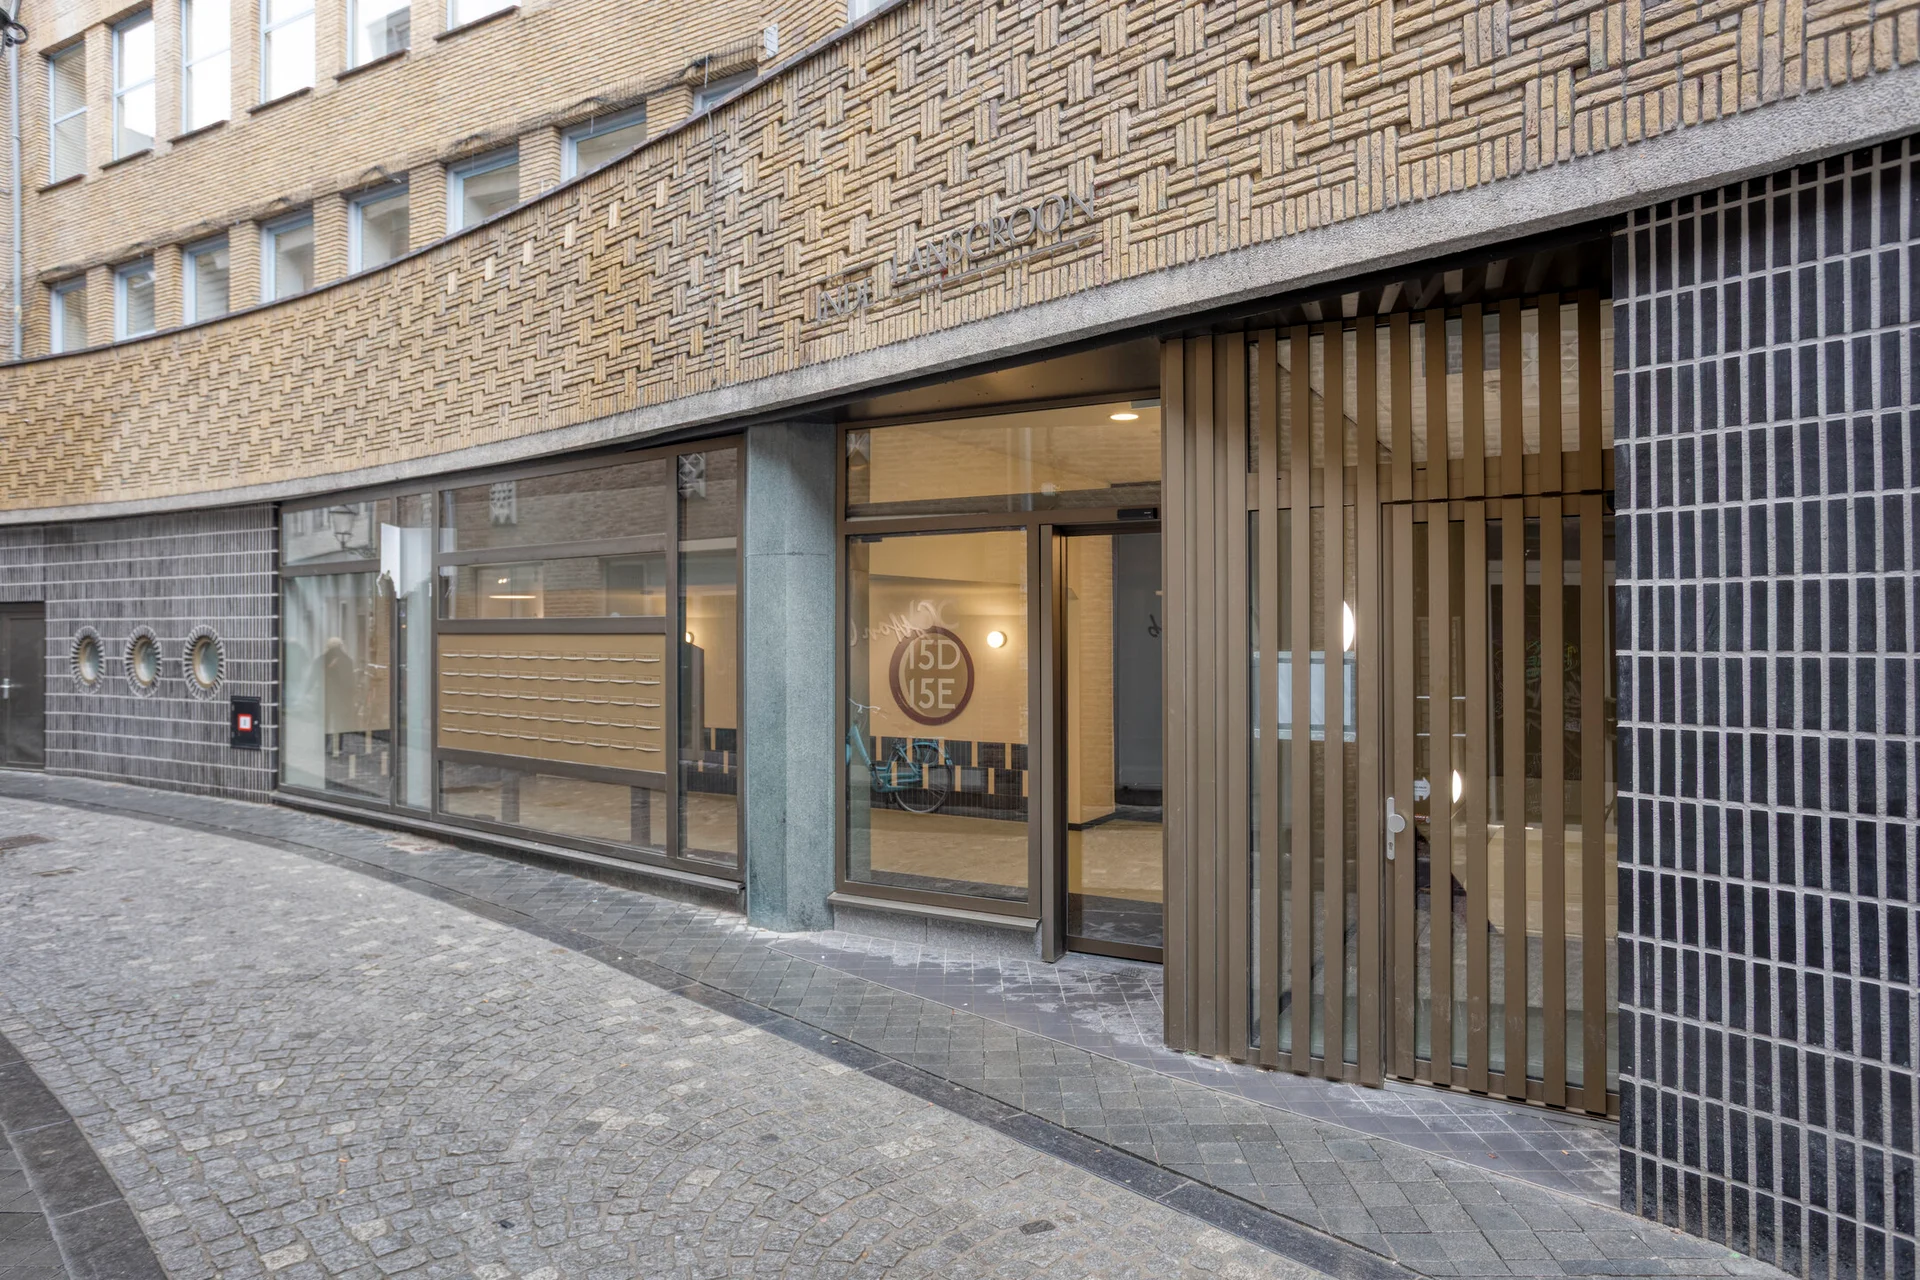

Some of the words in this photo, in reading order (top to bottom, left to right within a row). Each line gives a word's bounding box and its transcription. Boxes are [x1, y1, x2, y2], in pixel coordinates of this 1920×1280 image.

[892, 182, 1095, 282] LANSCROON
[908, 639, 961, 671] 15D
[908, 678, 956, 709] 15E
